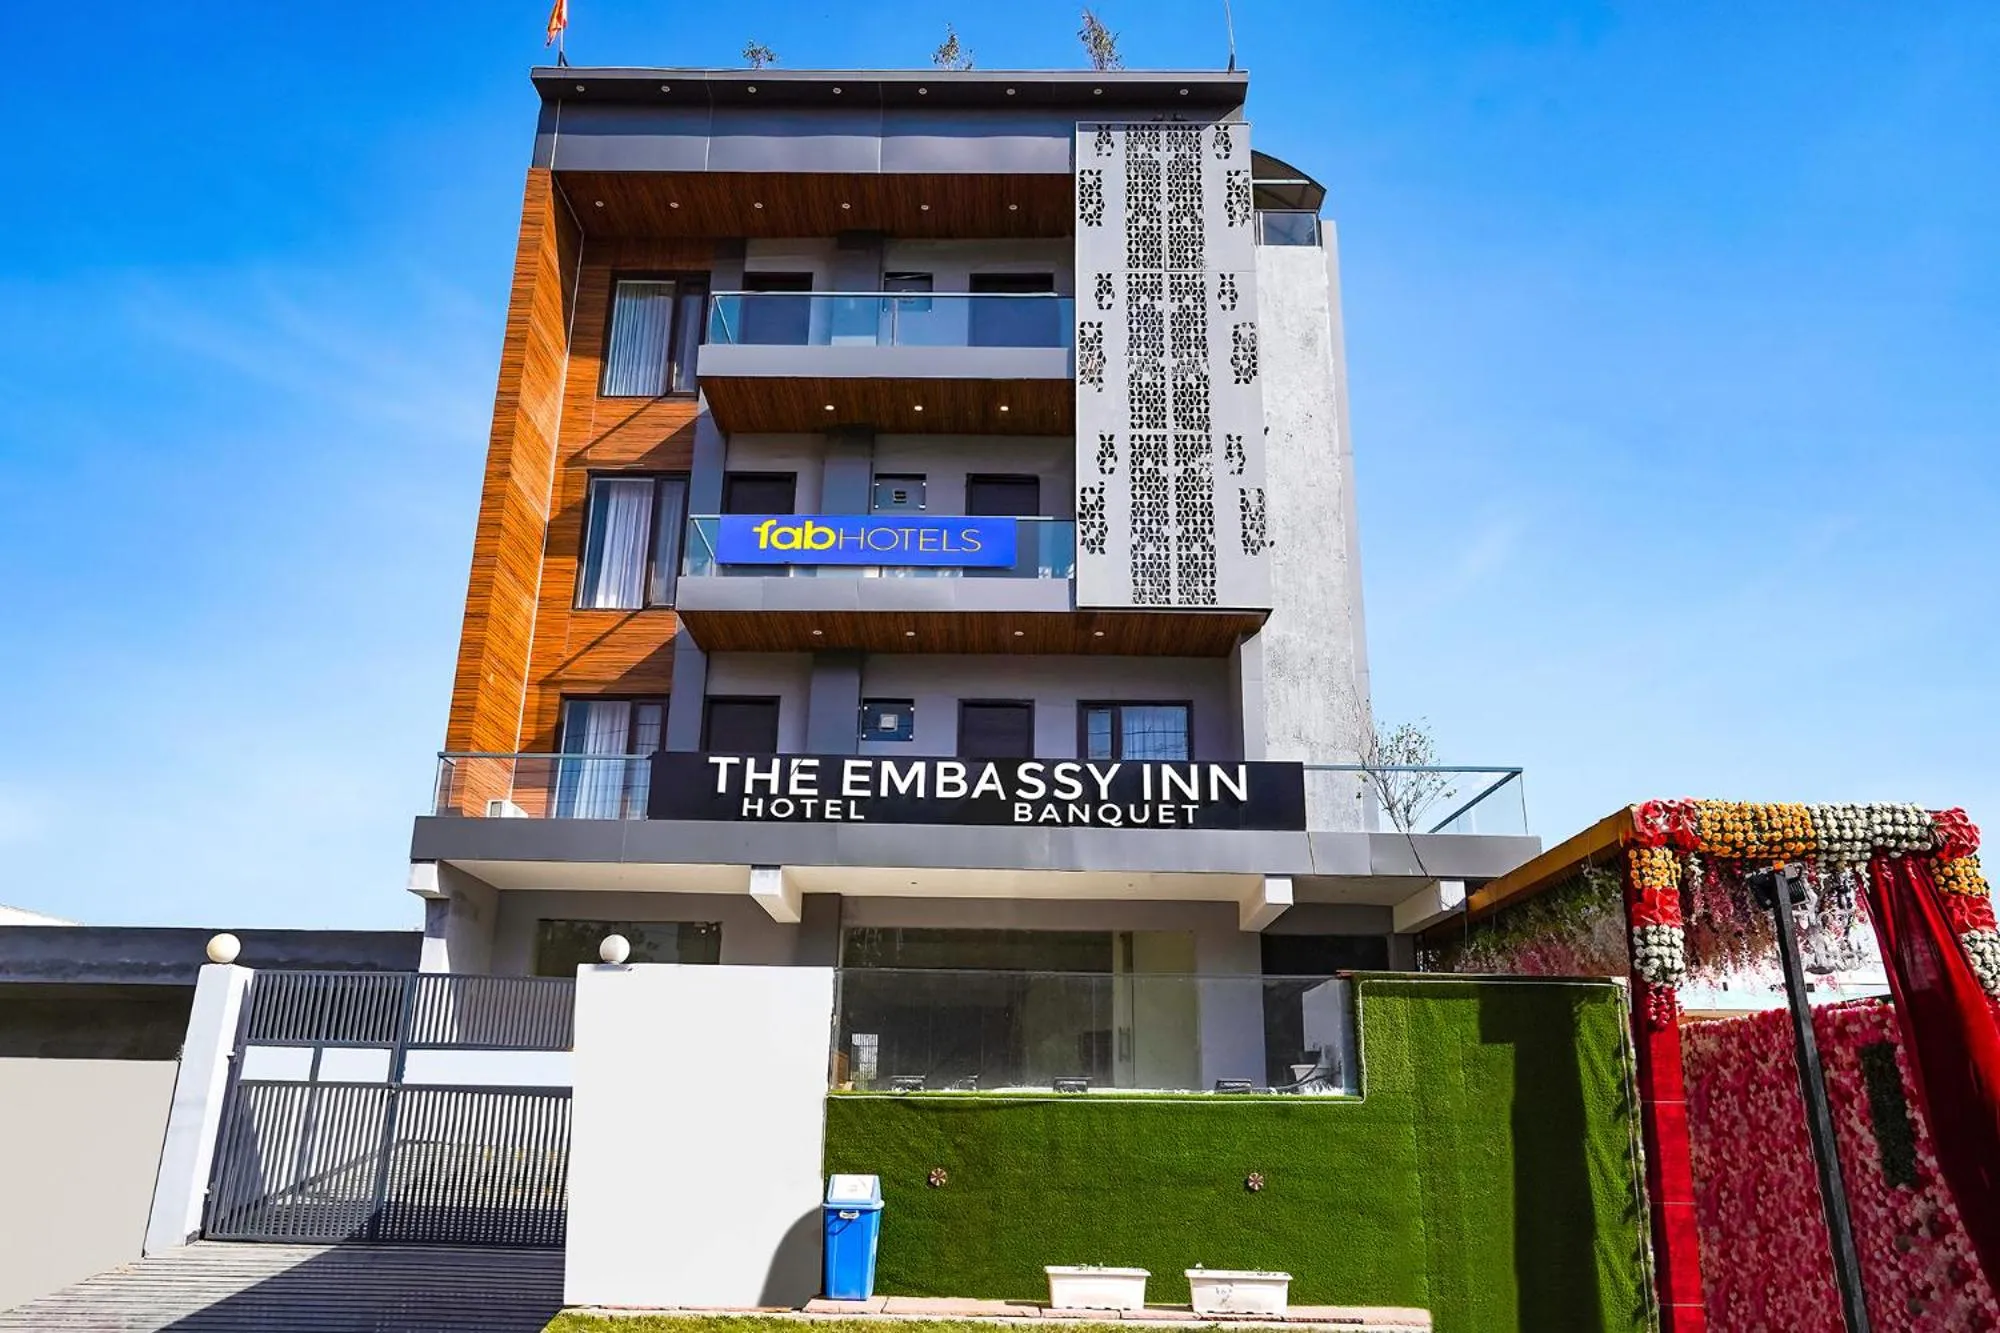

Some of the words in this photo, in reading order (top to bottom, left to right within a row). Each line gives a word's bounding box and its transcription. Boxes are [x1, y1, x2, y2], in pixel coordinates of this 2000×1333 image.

[708, 756, 820, 796] THE
[842, 759, 1122, 801] EMBASSY
[1143, 763, 1248, 801] INN
[742, 798, 865, 820] HOTEL
[1014, 803, 1200, 827] BANQUET
